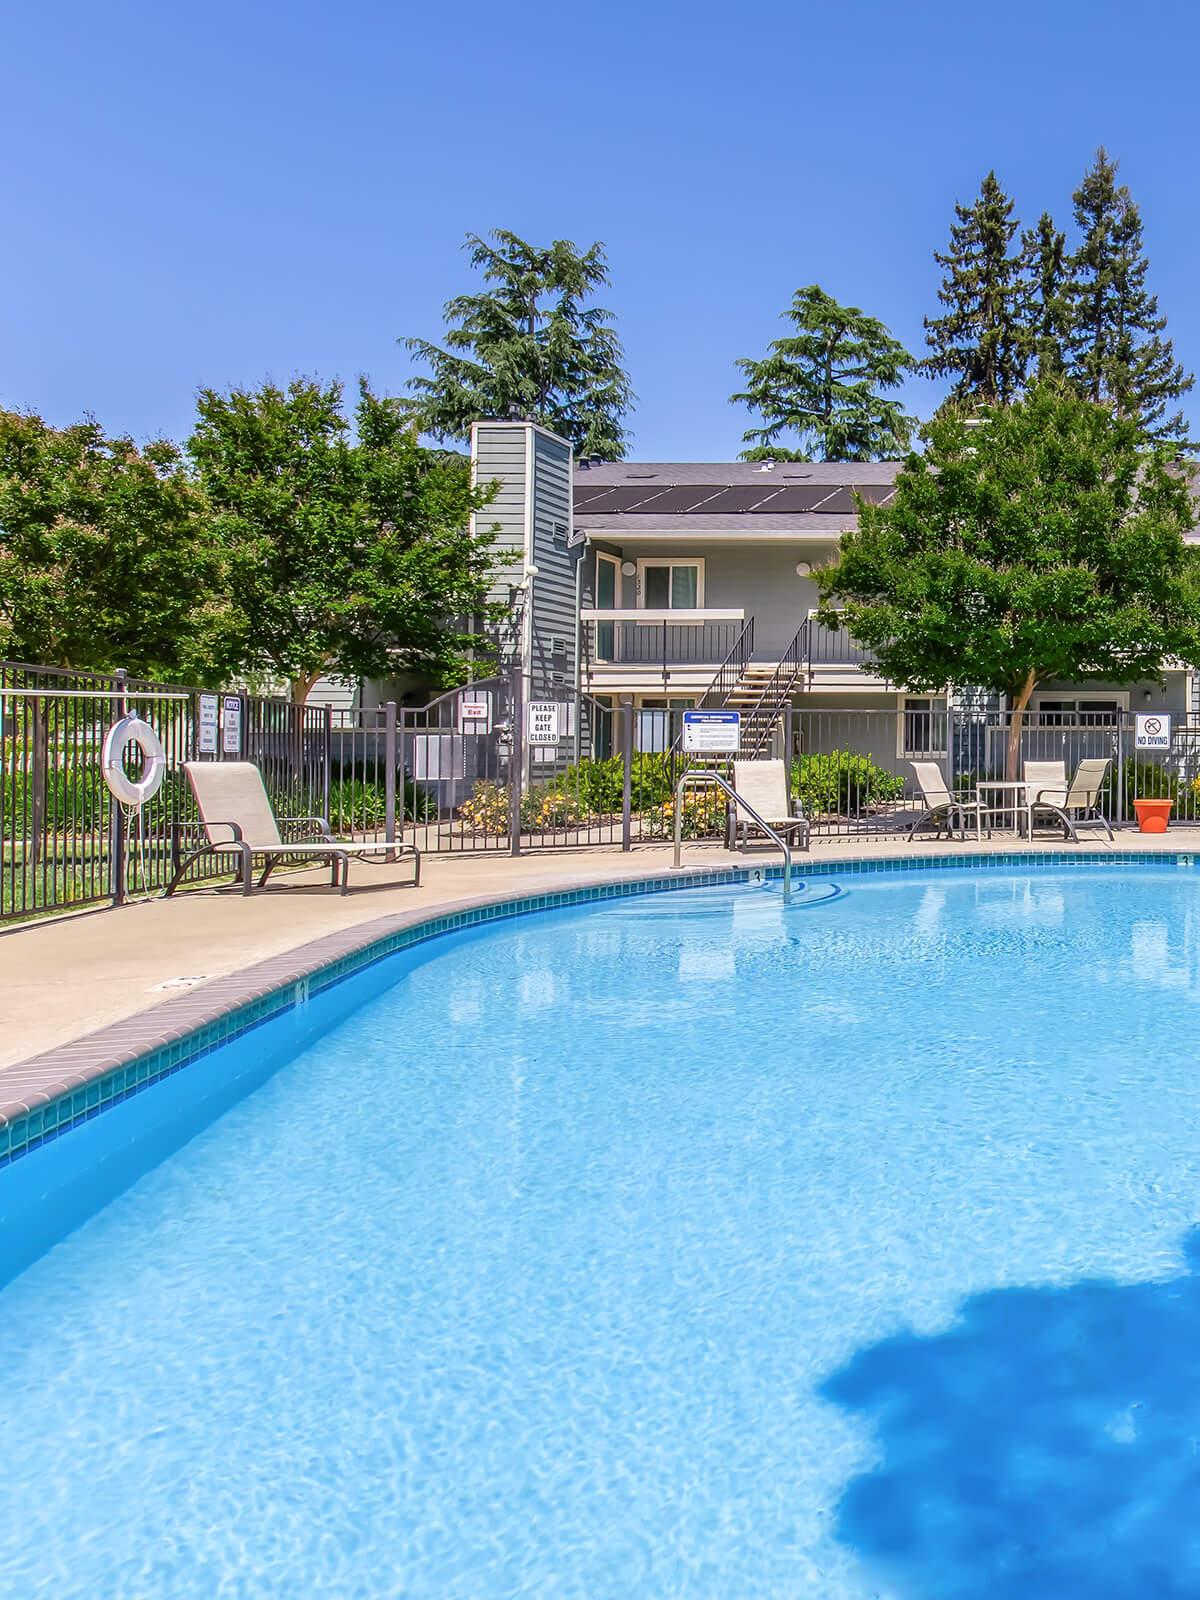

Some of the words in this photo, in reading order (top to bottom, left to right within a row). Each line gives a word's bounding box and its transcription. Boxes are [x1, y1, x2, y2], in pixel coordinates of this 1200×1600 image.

[530, 733, 557, 741] CLOSED
[1137, 736, 1147, 745] NO
[1148, 736, 1168, 745] DIVING
